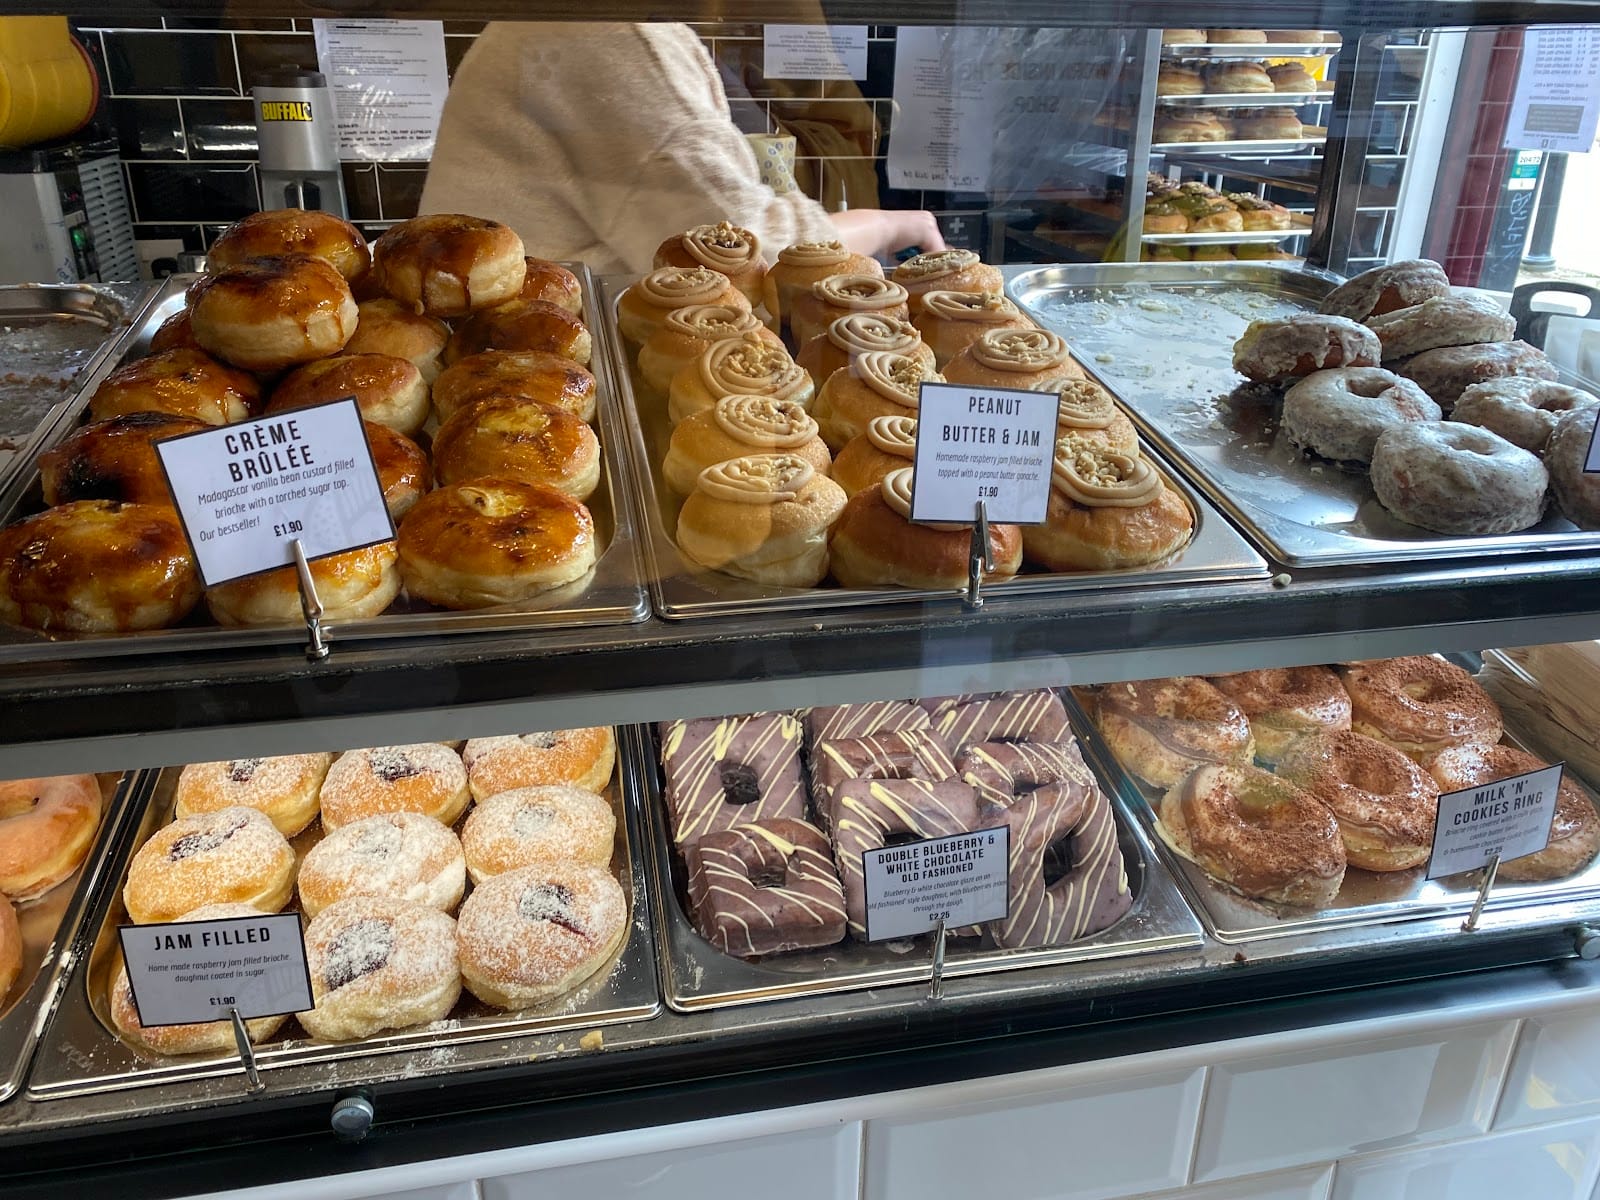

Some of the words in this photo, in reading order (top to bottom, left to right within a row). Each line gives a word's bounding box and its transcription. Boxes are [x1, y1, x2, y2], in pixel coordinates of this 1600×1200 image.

[261, 102, 312, 121] BUFFALO
[969, 396, 1021, 415] PEANUT
[225, 420, 301, 454] CRÈME
[943, 425, 995, 444] BUTTER
[1002, 429, 1009, 444] &
[1016, 430, 1040, 446] JAM
[228, 445, 314, 482] BRÛLÉE
[936, 452, 969, 462] Homemade
[970, 454, 996, 465] raspberry
[997, 457, 1008, 466] jam
[1009, 456, 1022, 465] filled
[1023, 457, 1042, 466] brioche
[198, 485, 248, 505] Madagascar
[251, 477, 278, 492] vanilla
[280, 472, 300, 484] bean
[302, 463, 332, 480] custard
[334, 458, 354, 474] filled
[938, 468, 959, 478] topped
[961, 469, 973, 478] with
[980, 471, 998, 479] peanut
[1000, 471, 1016, 480] butter
[215, 502, 246, 519] brioche
[248, 497, 267, 511] with
[269, 497, 274, 505] a
[276, 487, 306, 504] torched
[308, 483, 331, 499] sugar
[333, 479, 349, 494] top.
[979, 486, 998, 497] £1.90
[200, 528, 214, 541] Our
[217, 516, 260, 536] bestseller!
[274, 520, 302, 536] £1.90
[1474, 786, 1505, 806] MILK
[1454, 801, 1508, 825] COOKIES
[1514, 792, 1542, 811] RING
[878, 848, 919, 864] DOUBLE
[924, 837, 984, 856] BLUEBERRY
[988, 835, 994, 844] &
[886, 862, 919, 874] WHITE
[924, 849, 984, 868] CHOCOLATE
[902, 871, 919, 882] OLD
[923, 862, 973, 879] FASHIONED
[884, 888, 910, 898] Blueberry
[918, 884, 932, 892] white
[934, 880, 959, 890] chocolate
[914, 904, 935, 912] through
[930, 911, 950, 920] £2.25
[155, 934, 192, 950] JAM
[202, 927, 270, 947] FILLED
[149, 964, 168, 972] Home
[170, 963, 190, 971] made
[192, 960, 227, 971] raspberry
[228, 959, 241, 968] jam
[243, 957, 262, 966] filled
[175, 974, 208, 983] doughnut
[211, 971, 234, 980] coated
[210, 997, 235, 1005] £1.90
